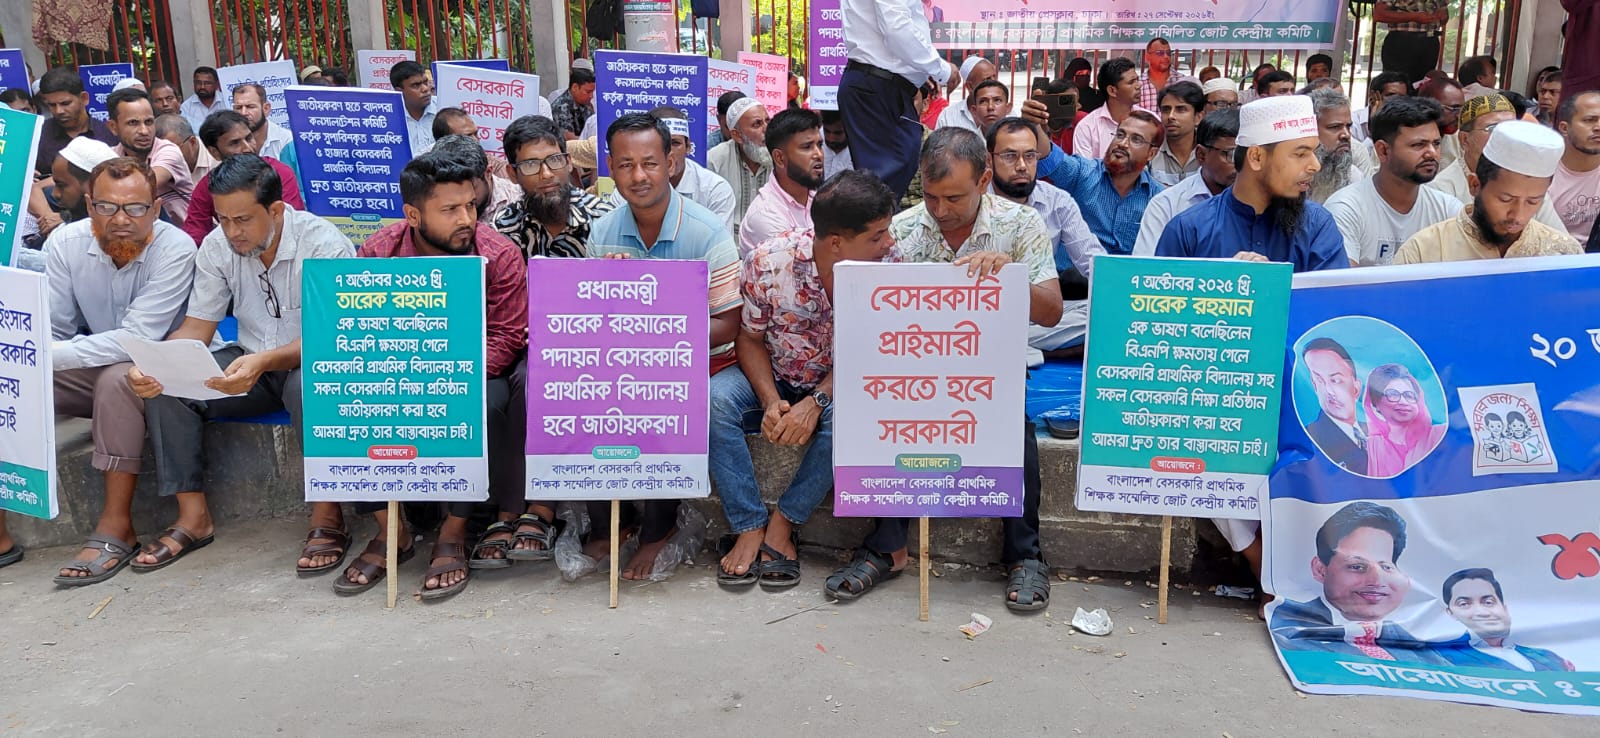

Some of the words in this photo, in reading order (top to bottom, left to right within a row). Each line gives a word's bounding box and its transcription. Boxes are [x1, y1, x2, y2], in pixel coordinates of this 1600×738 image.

[1060, 25, 1105, 39] প্রাথমিক
[1109, 25, 1145, 38] শিক্ষক
[1199, 26, 1229, 38] জোট
[1232, 25, 1273, 39] কেন্দ্রীয়
[606, 58, 650, 73] জাতীয়করণ
[651, 63, 667, 74] হতে
[669, 64, 698, 75] বাদপরা
[456, 77, 525, 99] বেসরকারি
[665, 77, 690, 90] কমিটি
[297, 97, 343, 111] জাতীয়করণ
[344, 101, 361, 112] হতে
[363, 102, 393, 113] বাদপরা
[602, 91, 624, 105] কর্তৃক
[362, 116, 388, 129] কমিটি
[299, 131, 321, 145] কর্তৃক
[322, 130, 367, 146] সুপারিশকৃত
[316, 148, 322, 157] ৫
[323, 148, 349, 158] হাজার
[351, 147, 393, 159] বেসরকারি
[323, 161, 354, 174] প্রাথমিক
[356, 161, 391, 176] বিদ্যালয়
[310, 180, 330, 193] দ্রুত
[331, 177, 388, 194] জাতীয়করণ
[328, 197, 362, 209] করতে
[1379, 244, 1389, 258] F
[336, 273, 342, 287] ৭
[346, 270, 391, 288] অক্টোবর
[395, 274, 426, 288] ২০২৫
[1131, 275, 1139, 288] ৭
[1143, 273, 1195, 291] অক্টোবর
[1198, 278, 1234, 293] ২০২৫
[577, 273, 658, 306] প্রধানমন্ত্রী
[870, 275, 1002, 312] বেসরকারি
[336, 292, 387, 309] তারেক
[391, 292, 447, 309] রহমান
[1130, 294, 1188, 314] তারেক
[1192, 296, 1254, 317] রহমান
[336, 317, 354, 331] এক
[357, 317, 389, 331] ভাষণে
[392, 312, 447, 332] বলেছিলেন
[546, 314, 603, 334] তারেক
[607, 314, 688, 335] রহমানের
[1128, 321, 1148, 335] এক
[1152, 321, 1188, 337] ভাষণে
[1191, 320, 1252, 341] বলেছিলেন
[336, 334, 375, 352] বিএনপি
[378, 338, 418, 353] ক্ষমতায়
[422, 338, 448, 353] গেলে
[878, 320, 981, 359] প্রাইমারী
[540, 348, 601, 369] পদায়ন
[606, 341, 693, 368] বেসরকারি
[1125, 340, 1170, 360] বিএনপি
[1173, 345, 1217, 362] ক্ষমতায়
[1220, 348, 1249, 363] গেলে
[1530, 333, 1577, 367] ২০
[312, 356, 364, 374] বেসরকারি
[366, 356, 407, 374] প্রাথমিক
[410, 356, 454, 375] বিদ্যালয়
[457, 360, 474, 375] সহ
[1096, 363, 1155, 381] বেসরকারি
[1157, 364, 1202, 383] প্রাথমিক
[1205, 365, 1254, 387] বিদ্যালয়
[1257, 373, 1275, 388] সহ
[313, 382, 341, 396] সকল
[344, 377, 396, 396] বেসরকারি
[399, 377, 424, 396] শিক্ষা
[426, 376, 468, 396] প্রতিষ্ঠান
[543, 374, 612, 401] প্রাথমিক
[616, 374, 690, 403] বিদ্যালয়
[863, 376, 939, 401] করতে
[946, 376, 995, 402] হবে
[1096, 388, 1126, 403] সকল
[1129, 386, 1188, 406] বেসরকারি
[1191, 389, 1219, 408] শিক্ষা
[1221, 390, 1267, 410] প্রতিষ্ঠান
[402, 404, 424, 418] করা
[427, 404, 447, 418] হবে
[1487, 393, 1512, 405] জন্য
[1516, 397, 1540, 428] শিক্ষা
[313, 425, 347, 439] আমরা
[348, 425, 369, 441] দ্রুত
[372, 425, 392, 439] তার
[543, 415, 577, 436] হবে
[877, 409, 978, 445] সরকারী
[1193, 416, 1216, 431] করা
[1220, 418, 1242, 432] হবে
[1092, 433, 1129, 449] আমরা
[1130, 434, 1154, 452] দ্রুত
[1157, 436, 1180, 451] তার
[329, 464, 371, 477] বাংলাদেশ
[373, 461, 417, 476] বেসরকারি
[420, 461, 456, 476] প্রাথমিক
[552, 464, 594, 475] বাংলাদেশ
[598, 461, 642, 474] বেসরকারি
[645, 461, 681, 474] প্রাথমিক
[900, 457, 951, 469] আয়োজনে
[310, 478, 338, 493] শিক্ষক
[381, 479, 404, 493] জোট
[406, 478, 438, 493] কেন্দ্রীয়
[531, 478, 560, 490] শিক্ষক
[606, 478, 629, 490] জোট
[631, 476, 663, 491] কেন্দ্রীয়
[860, 477, 906, 490] বাংলাদেশ
[909, 475, 955, 490] বেসরকারি
[958, 475, 996, 490] প্রাথমিক
[1106, 474, 1153, 488] বাংলাদেশ
[1156, 476, 1203, 490] বেসরকারি
[1206, 478, 1246, 493] প্রাথমিক
[840, 491, 870, 505] শিক্ষক
[917, 492, 940, 506] জোট
[943, 490, 976, 507] কেন্দ্রীয়
[1084, 487, 1115, 502] শিক্ষক
[1163, 493, 1188, 507] জোট
[1190, 494, 1225, 510] কেন্দ্রীয়
[1228, 496, 1258, 511] কমিটি
[1335, 660, 1547, 698] আয়োজনে
